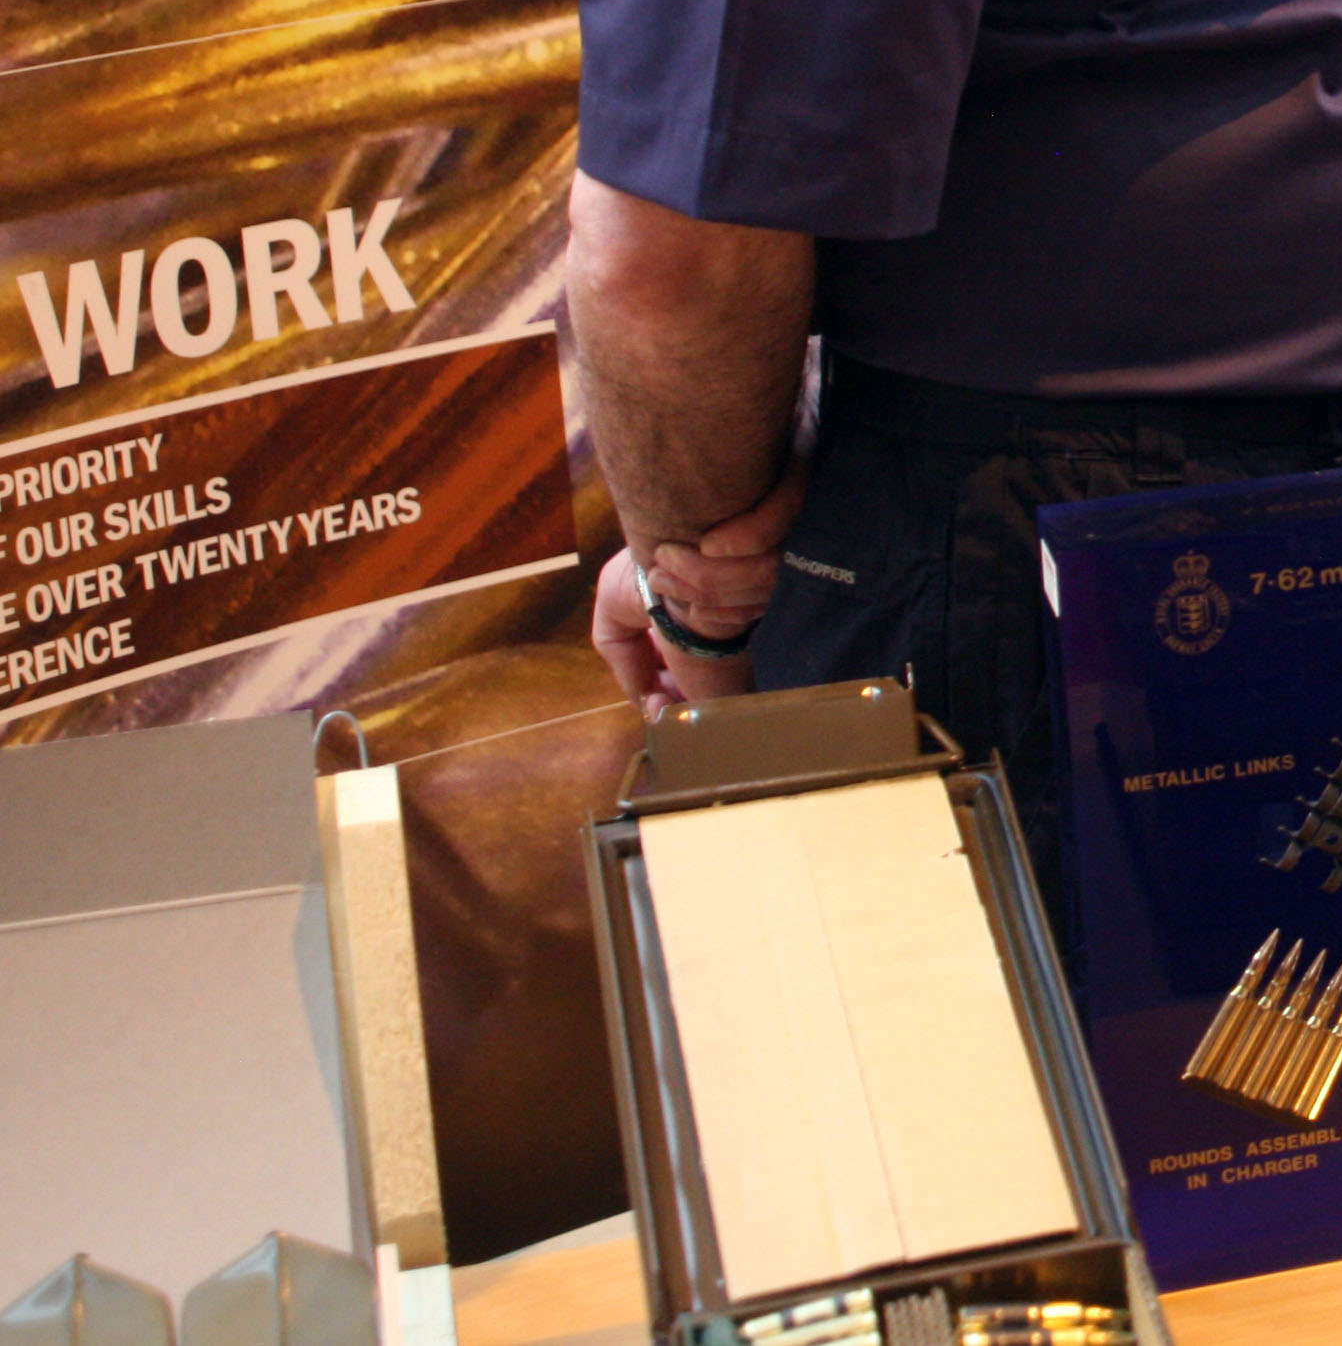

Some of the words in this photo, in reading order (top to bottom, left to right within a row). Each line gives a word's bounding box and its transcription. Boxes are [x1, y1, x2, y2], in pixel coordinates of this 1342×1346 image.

[17, 197, 416, 390] WORK
[0, 434, 163, 512] PRIORITY
[16, 512, 98, 565] OUR
[104, 477, 231, 541] SKILLS
[25, 563, 126, 622] OVER
[135, 516, 292, 590] TWENTY
[298, 487, 421, 546] YEARS
[1123, 764, 1225, 792] METALLIC
[1235, 754, 1295, 777] LINKS
[1150, 1145, 1234, 1174] ROUNDS
[1187, 1173, 1208, 1190] IN
[1222, 1153, 1318, 1184] CHARGER
